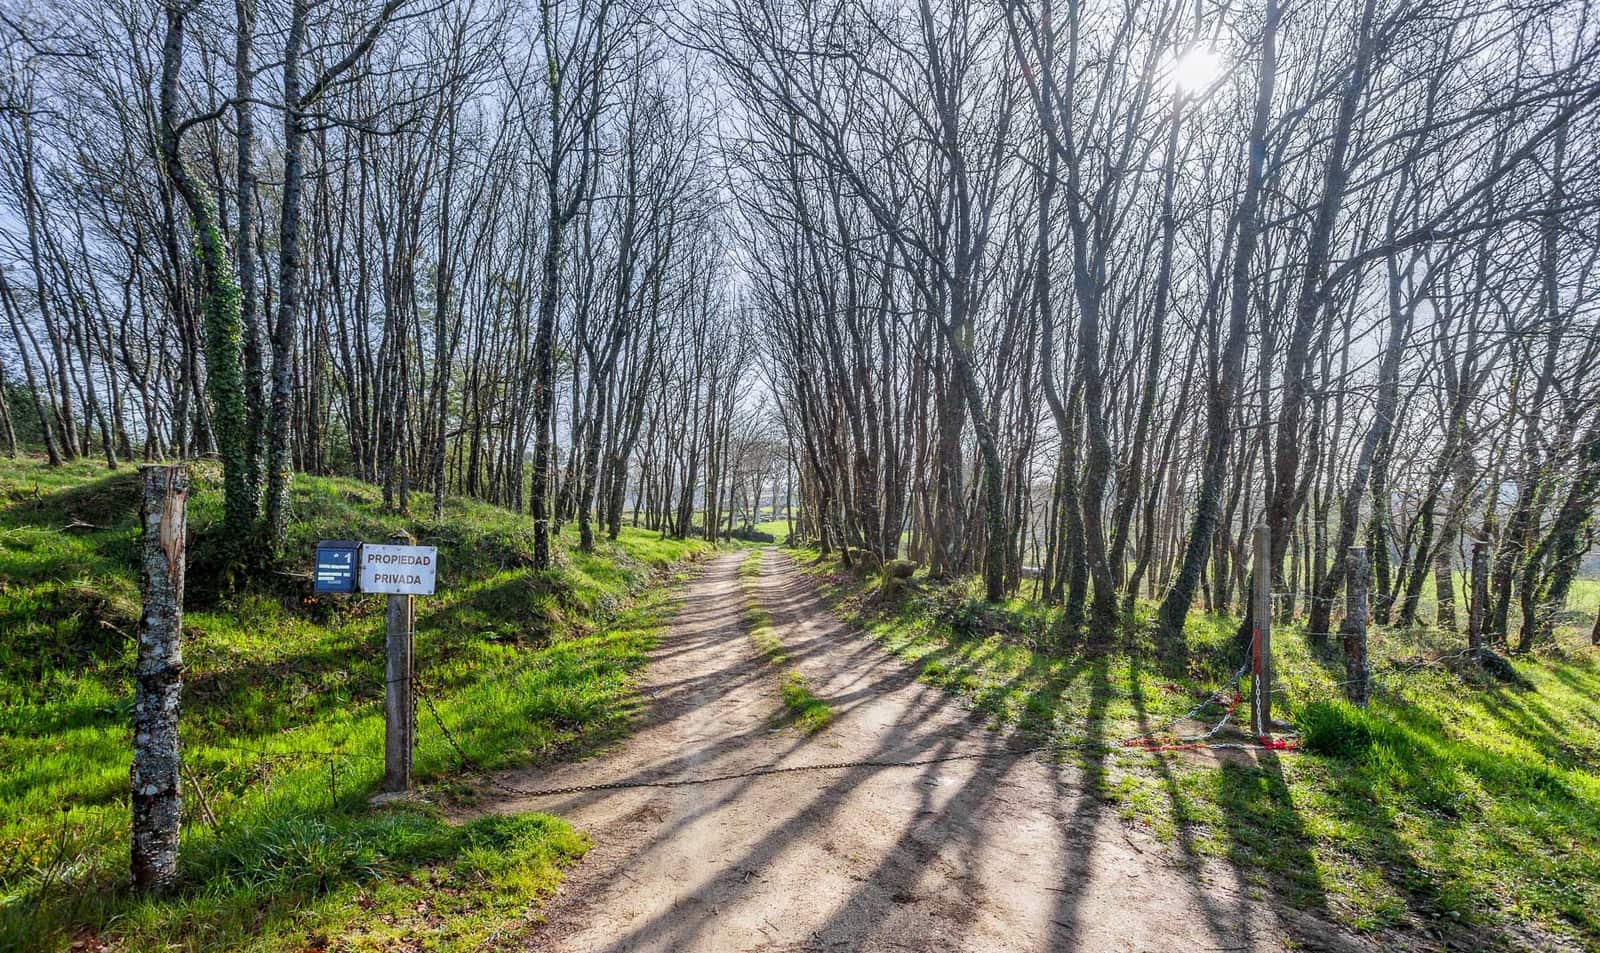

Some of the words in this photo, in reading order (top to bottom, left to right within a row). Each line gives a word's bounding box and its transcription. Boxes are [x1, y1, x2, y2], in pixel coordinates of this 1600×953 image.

[344, 552, 351, 563] 1
[368, 554, 430, 565] PROPIEDAD
[374, 573, 421, 584] PRIVADA
